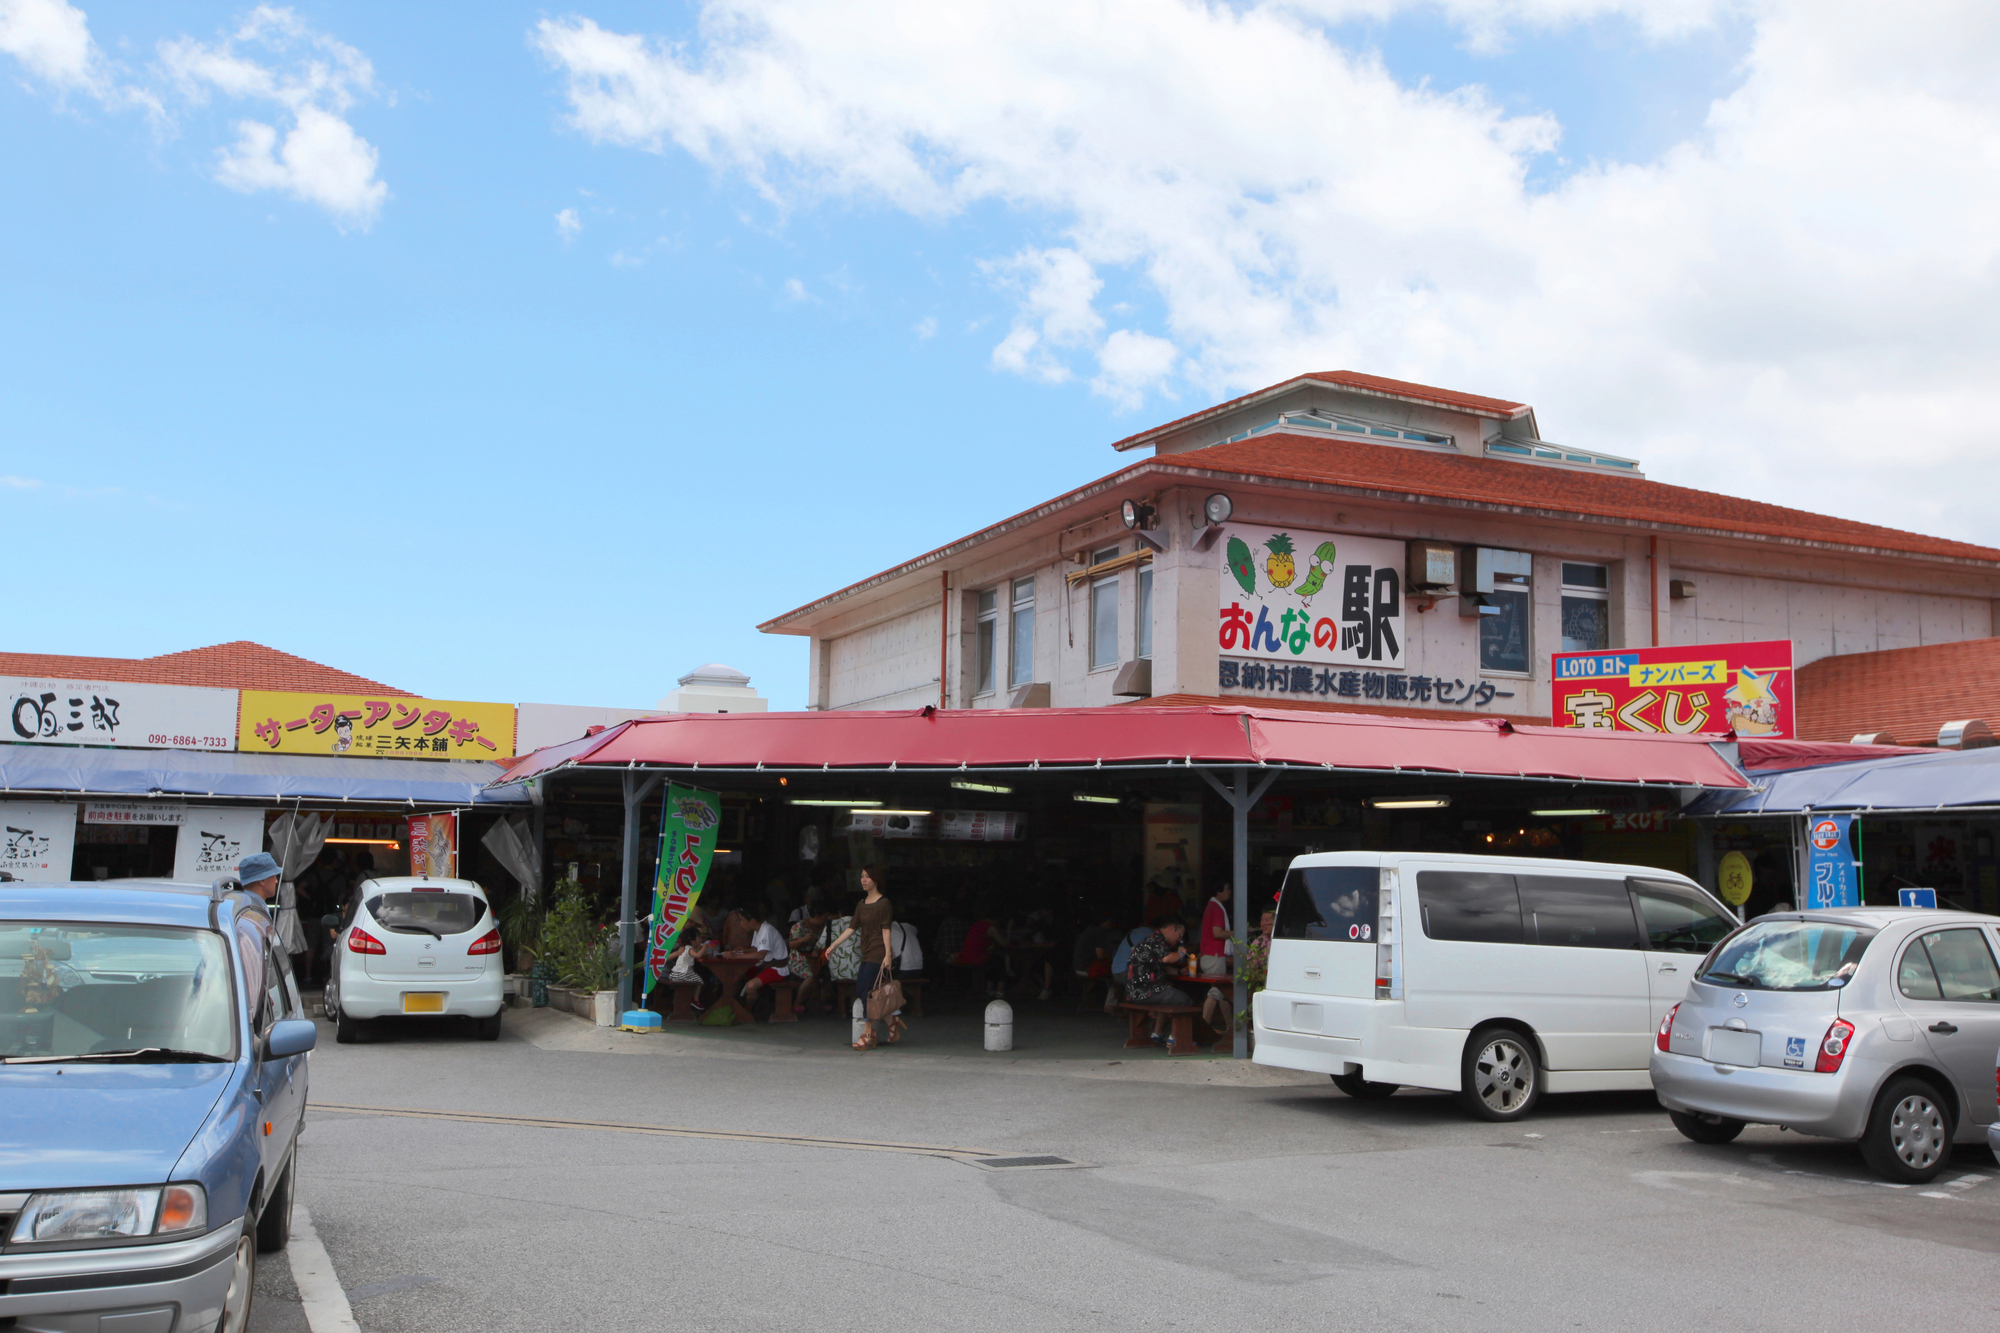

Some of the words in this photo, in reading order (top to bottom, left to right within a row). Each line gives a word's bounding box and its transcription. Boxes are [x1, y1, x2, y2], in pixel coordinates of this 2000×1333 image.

[1219, 564, 1400, 661] おんなの駅
[1562, 658, 1596, 676] LOTO
[1602, 657, 1628, 674] ロト
[1640, 663, 1716, 685] ナンバーズ
[1219, 659, 1515, 706] 恩納村農水産物販売センター
[1564, 689, 1711, 734] 宝くじ
[254, 701, 497, 751] サーターアンダギー
[148, 734, 227, 748] 090-6864-7333
[376, 735, 449, 752] 三矢本舗
[88, 810, 184, 822] 前向き駐車をお願いします。
